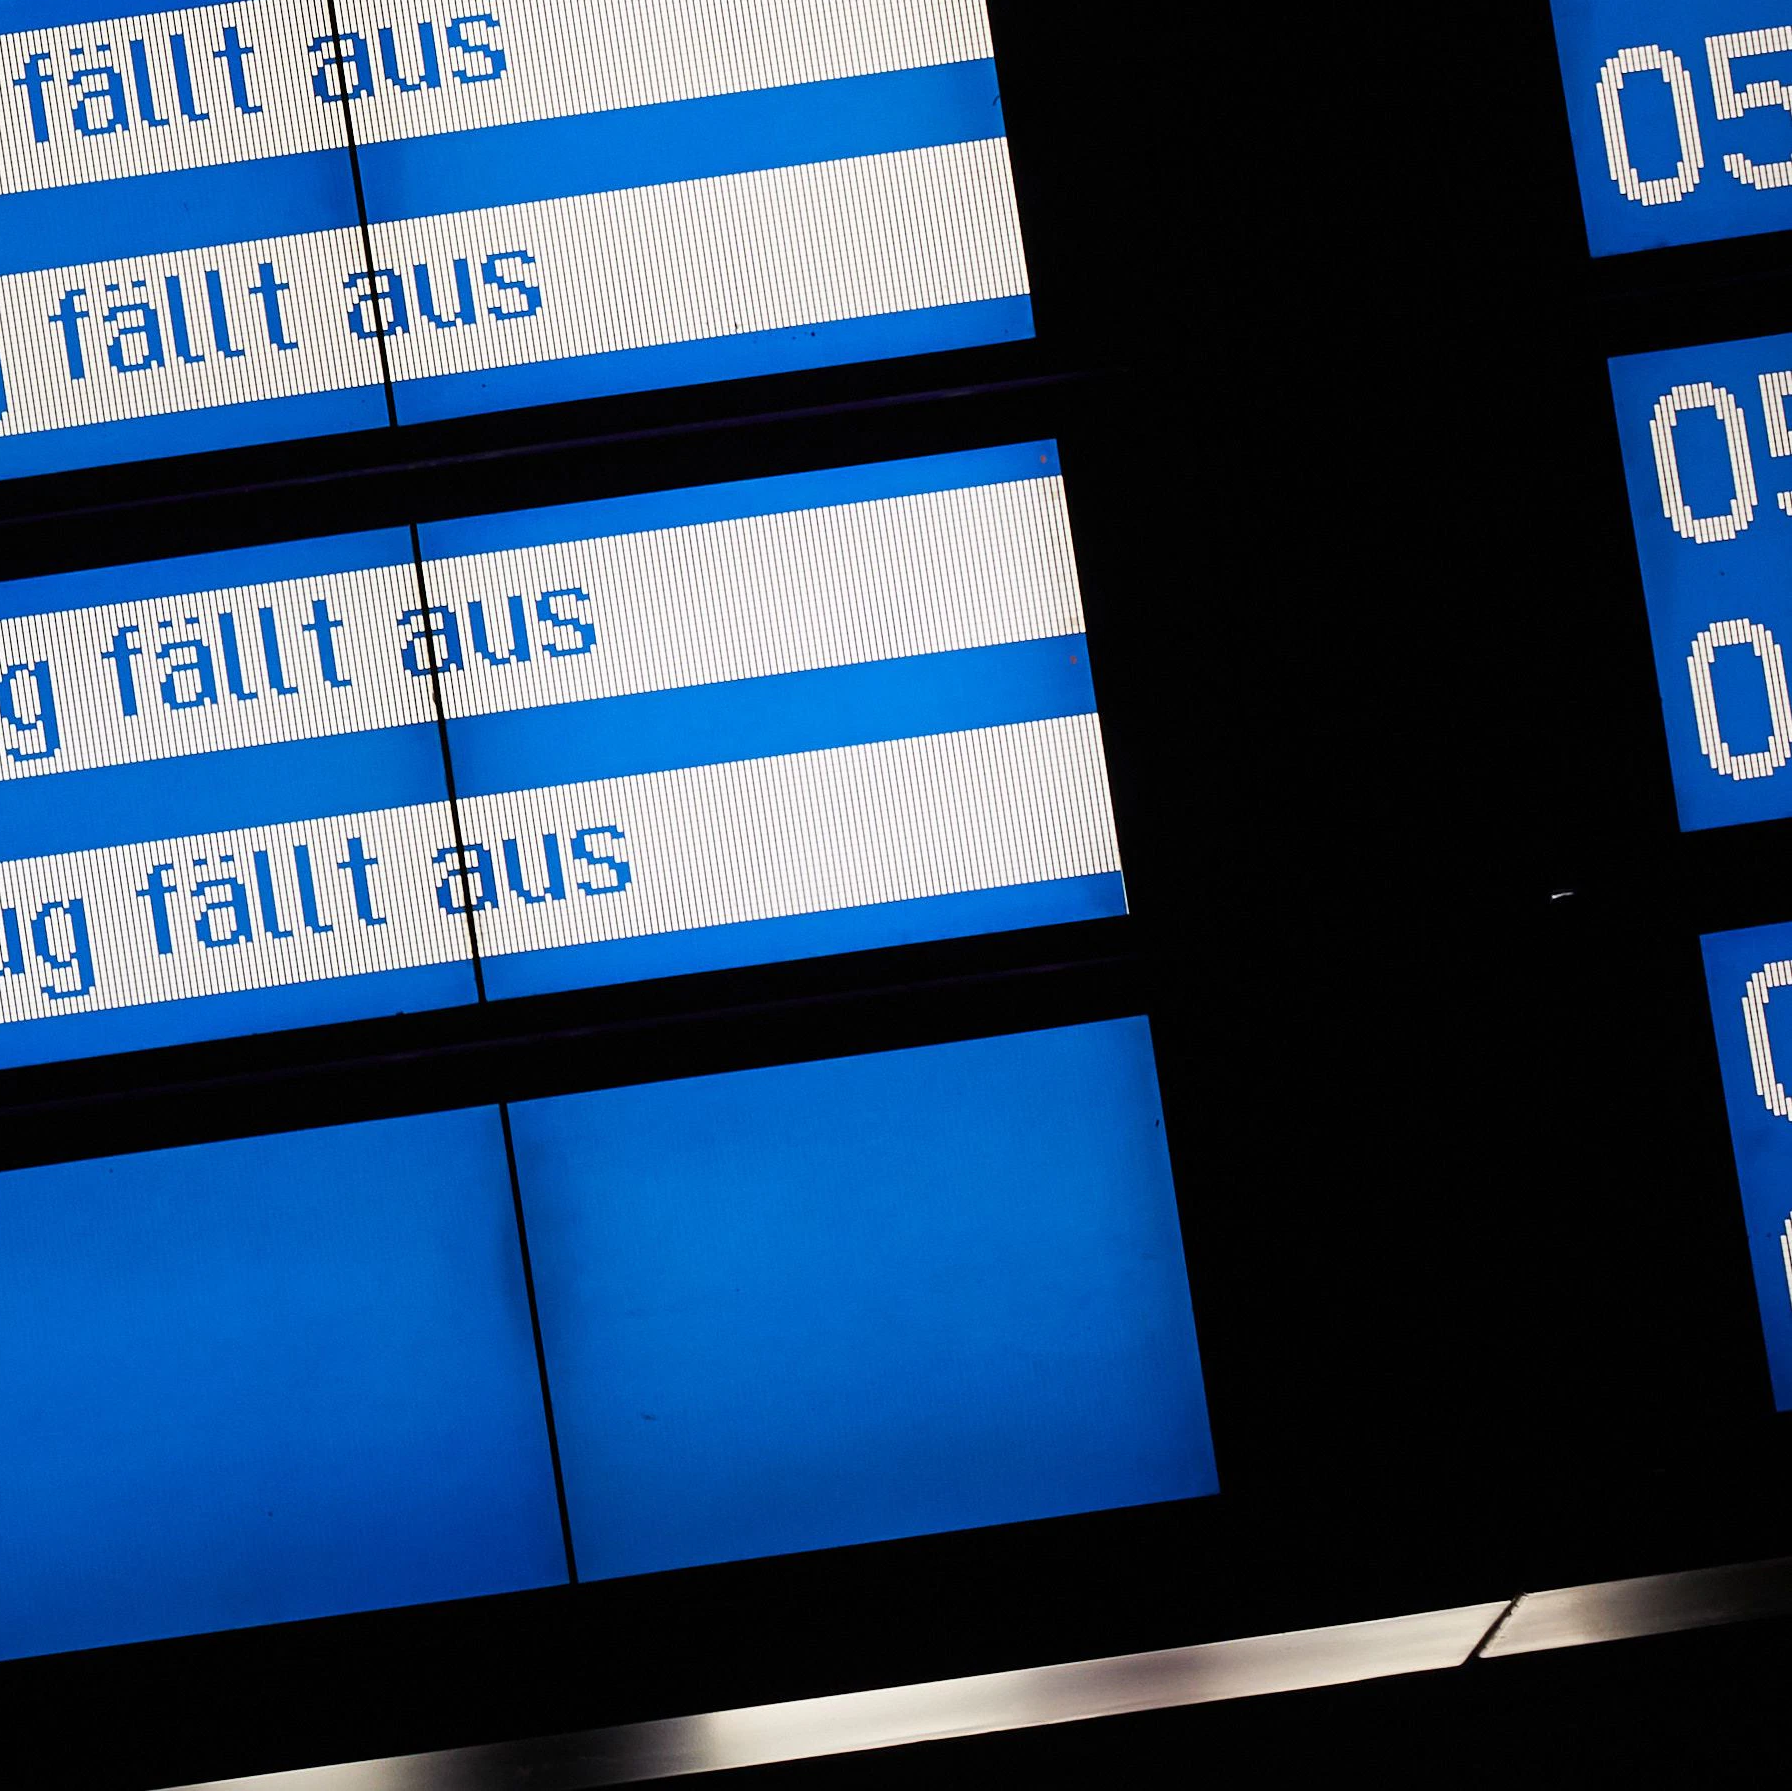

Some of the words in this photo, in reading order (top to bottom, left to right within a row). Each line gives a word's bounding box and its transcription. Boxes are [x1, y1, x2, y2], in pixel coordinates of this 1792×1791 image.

[12, 25, 262, 145] fällt
[310, 11, 509, 104] aus
[47, 260, 299, 382] fällt
[342, 248, 544, 341] aus
[100, 597, 353, 718] fällt
[399, 585, 599, 678] aus
[134, 835, 388, 957] fällt
[433, 823, 634, 917] aus
